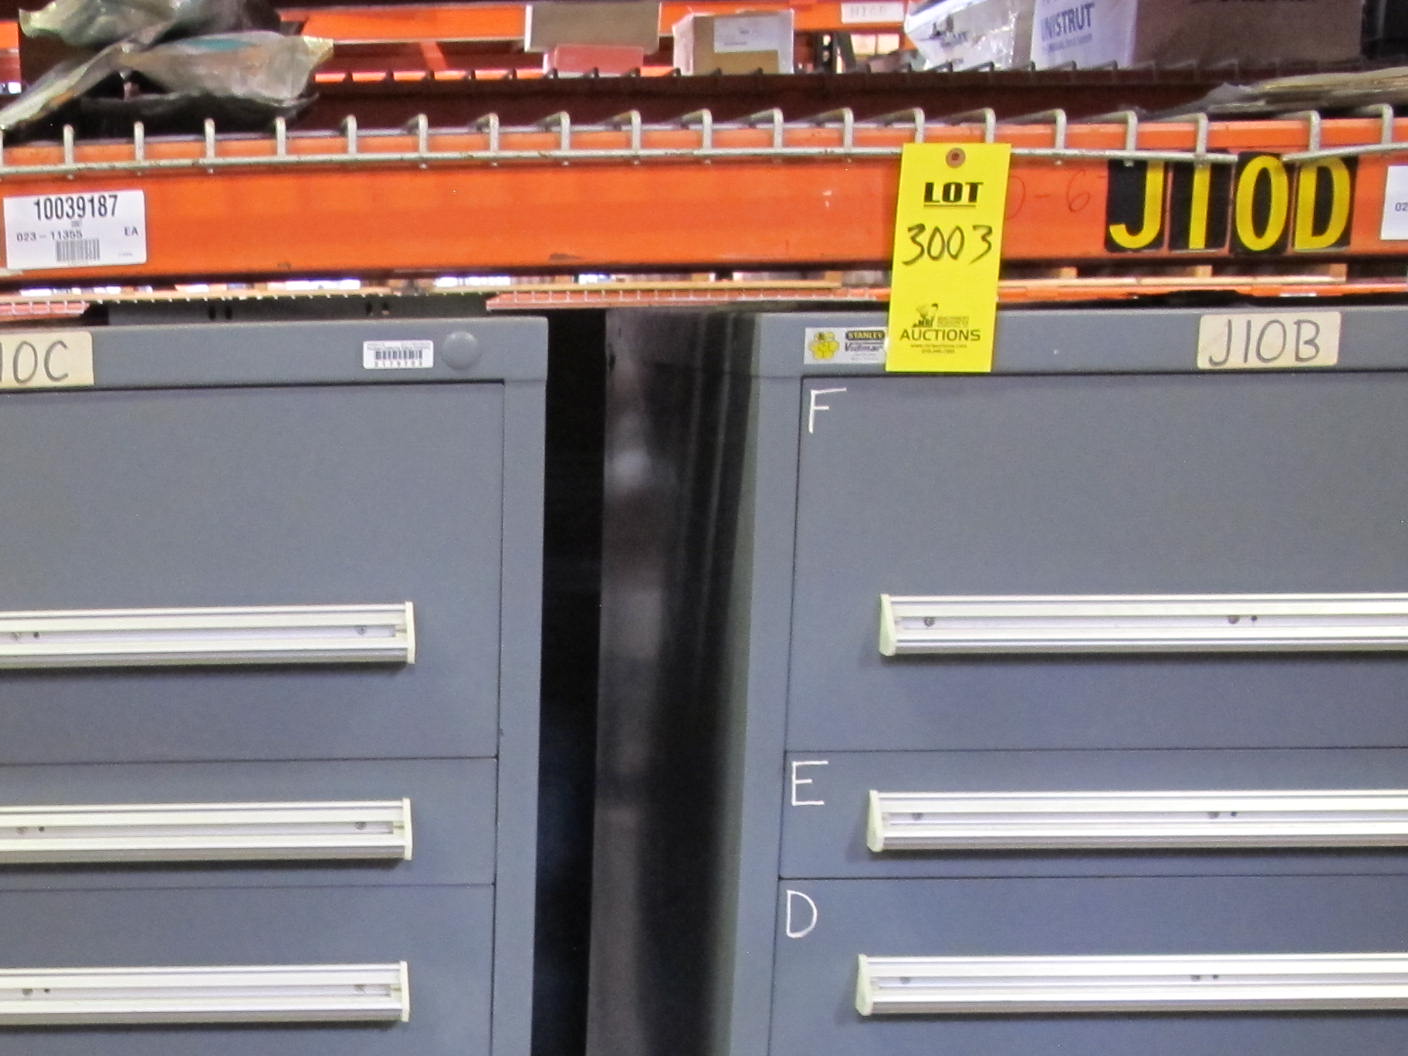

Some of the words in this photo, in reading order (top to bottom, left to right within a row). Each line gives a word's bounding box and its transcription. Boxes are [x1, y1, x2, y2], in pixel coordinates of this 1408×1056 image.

[33, 194, 119, 221] 10039187
[923, 181, 984, 203] LOT
[124, 226, 139, 236] EA
[902, 223, 993, 267] 3003
[900, 328, 982, 342] AUCTIONS
[809, 387, 848, 435] F
[792, 760, 830, 807] E
[786, 889, 818, 938] D
